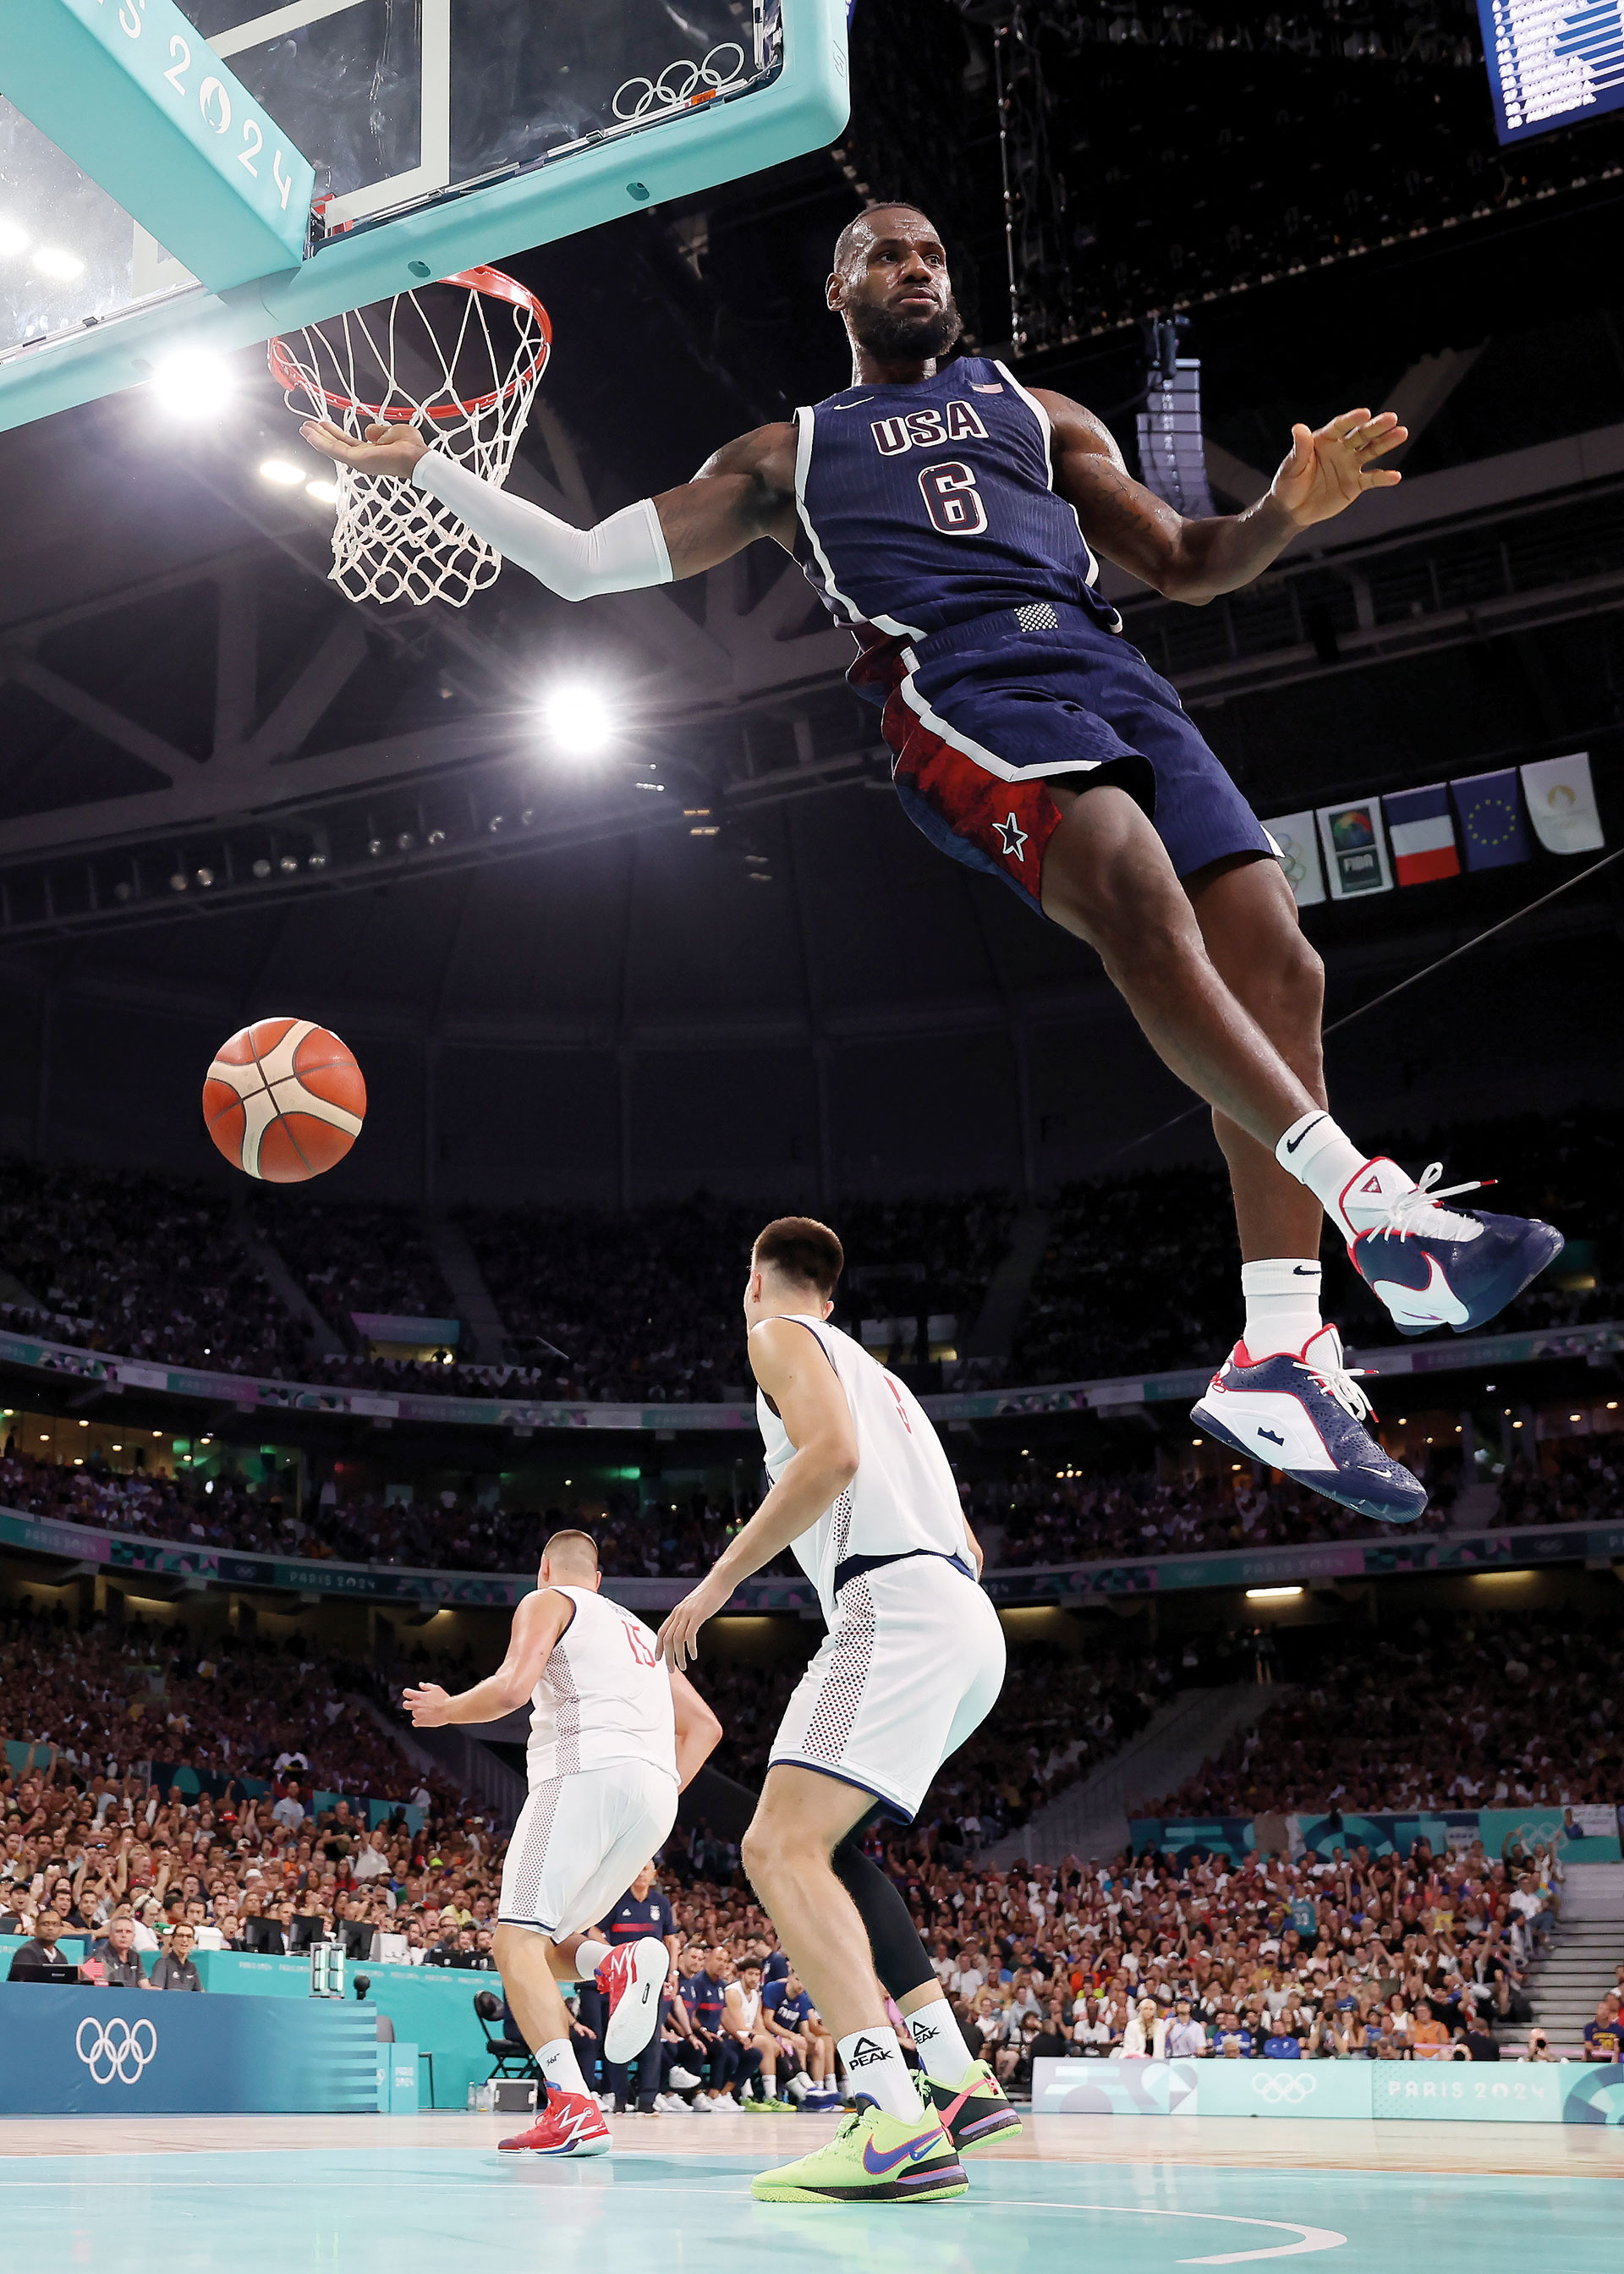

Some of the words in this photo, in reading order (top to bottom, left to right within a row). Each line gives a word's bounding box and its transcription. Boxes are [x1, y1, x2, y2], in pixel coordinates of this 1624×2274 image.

[162, 34, 292, 211] 2024
[870, 400, 990, 456] USA
[918, 461, 989, 536] 6
[289, 1571, 332, 1586] PARIS
[337, 1575, 375, 1590] 2024
[621, 1619, 656, 1668] 15
[848, 2050, 895, 2071] PEAK
[1388, 2080, 1464, 2099] PARIS
[1474, 2082, 1544, 2101] 2024
